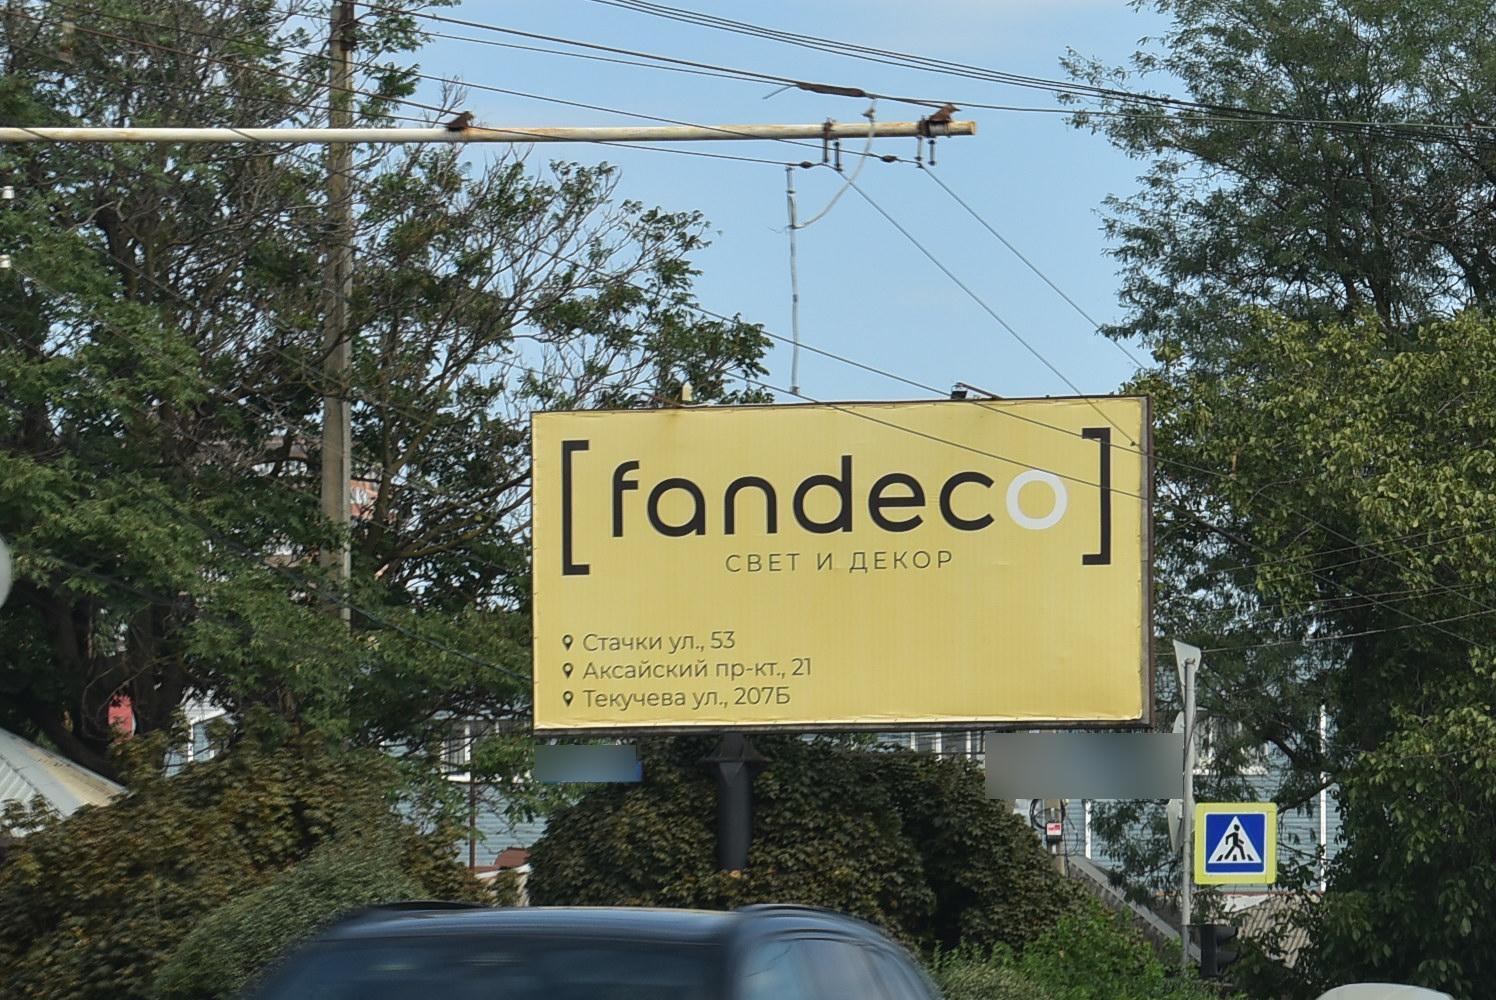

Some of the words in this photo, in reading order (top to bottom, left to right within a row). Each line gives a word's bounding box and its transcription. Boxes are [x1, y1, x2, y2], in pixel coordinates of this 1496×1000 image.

[725, 552, 801, 573] СВЕТ
[817, 552, 834, 571] И
[849, 550, 953, 573] ДЕКОР
[582, 632, 663, 652] Стачки
[668, 635, 705, 655] ул.,
[710, 630, 736, 650] 53
[582, 659, 708, 680] Аксайский
[715, 662, 786, 681] пр-кт.,
[791, 657, 812, 676] 21
[583, 688, 686, 712] Текучева
[692, 691, 728, 710] ул.,
[733, 686, 791, 706] 207Б
